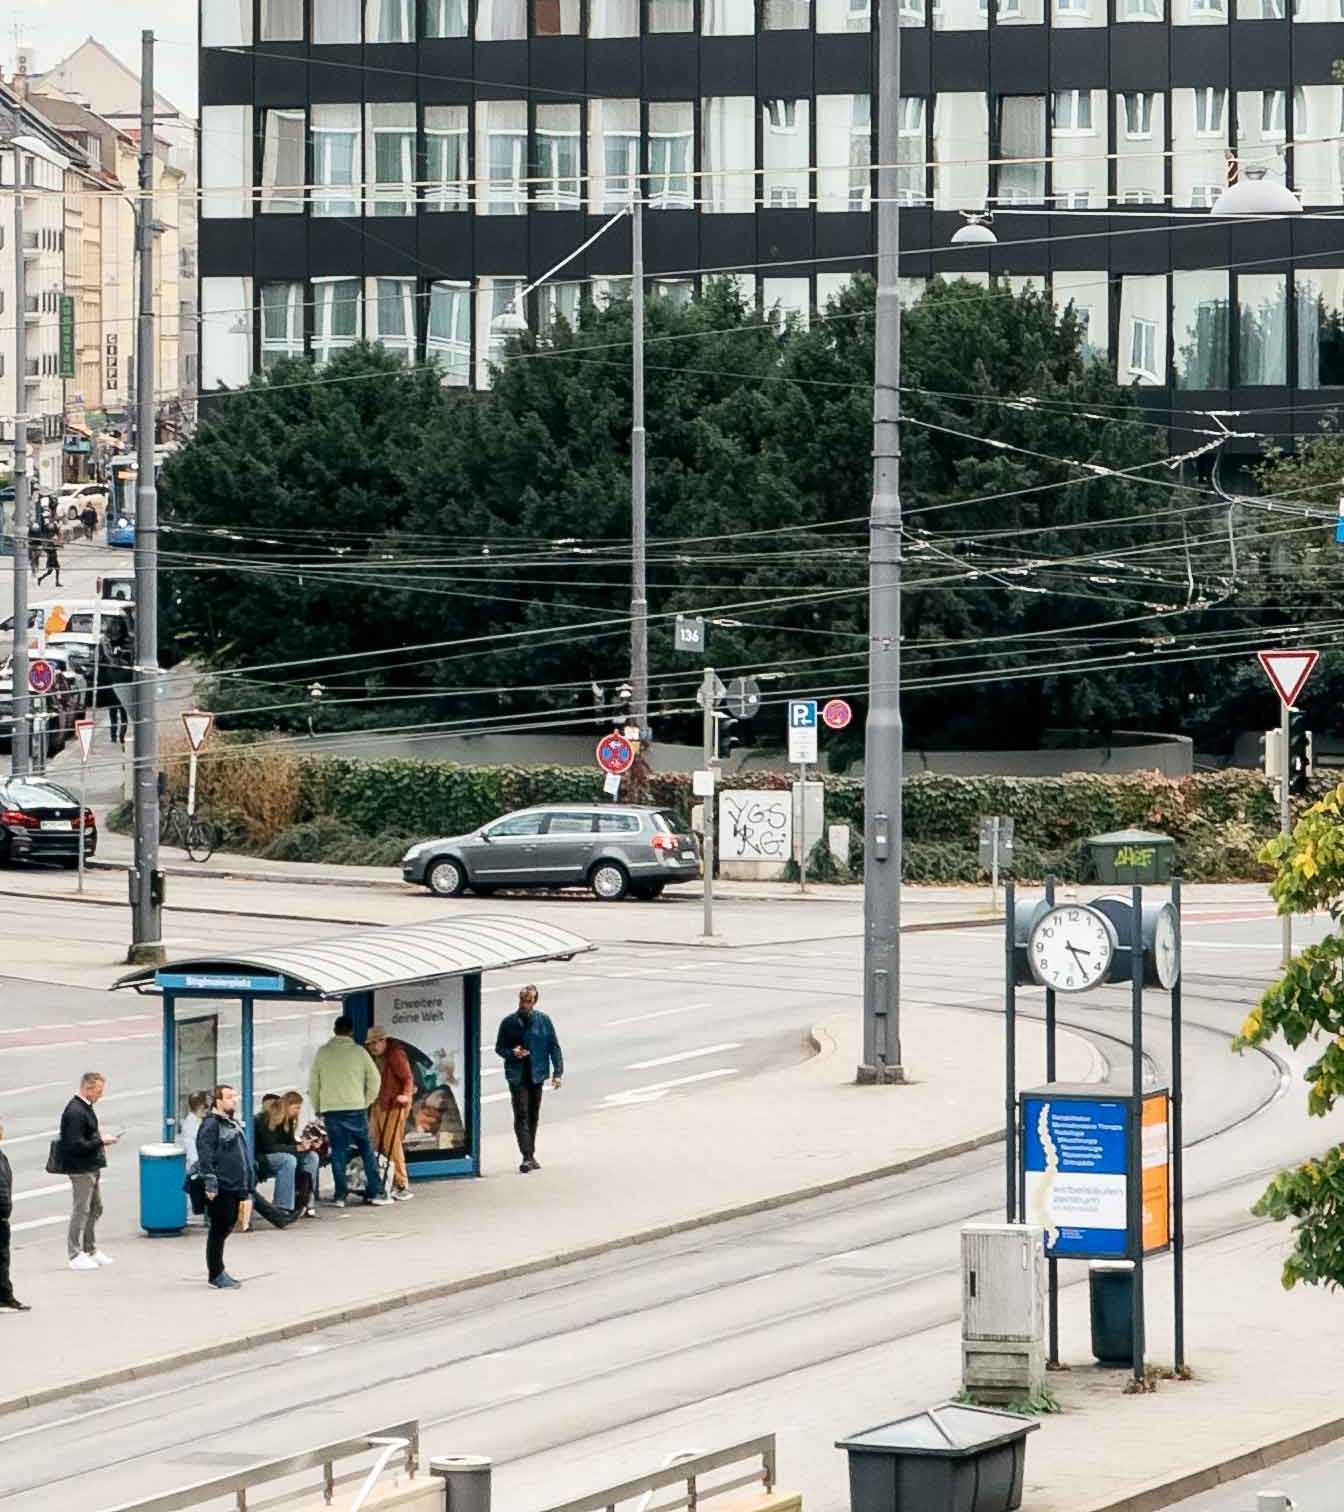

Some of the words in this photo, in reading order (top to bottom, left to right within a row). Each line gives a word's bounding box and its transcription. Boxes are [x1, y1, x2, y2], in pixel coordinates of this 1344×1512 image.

[680, 628, 699, 642] 136
[1067, 910, 1080, 922] 12
[1086, 916, 1092, 927] 1
[1041, 928, 1054, 938] 10
[1096, 928, 1104, 939] 2
[1036, 942, 1044, 952] 9
[1100, 945, 1108, 956] 3
[1040, 959, 1048, 969] 8
[1093, 961, 1102, 971] 4
[1053, 970, 1060, 981] 7
[1066, 976, 1074, 987] 6
[393, 998, 442, 1009] Erweitere
[392, 1013, 419, 1024] deine
[420, 1009, 444, 1021] Welt
